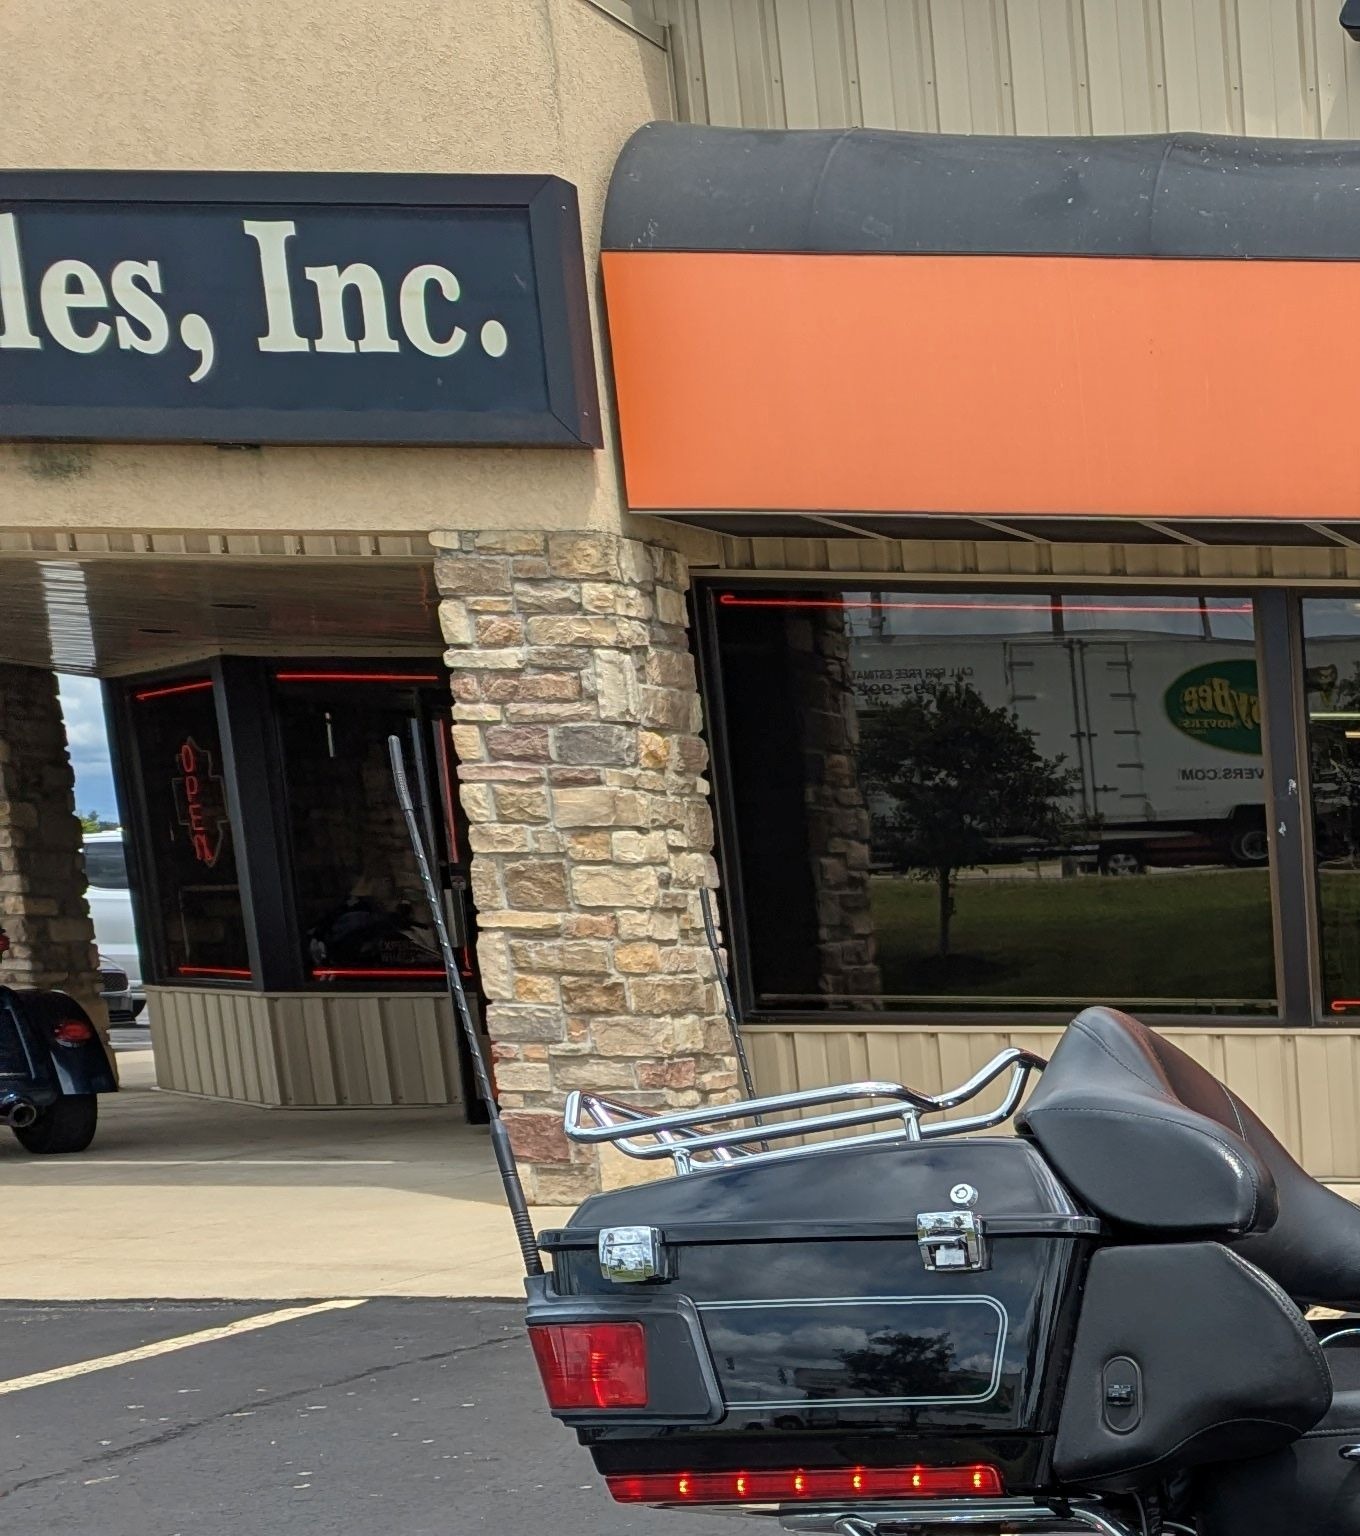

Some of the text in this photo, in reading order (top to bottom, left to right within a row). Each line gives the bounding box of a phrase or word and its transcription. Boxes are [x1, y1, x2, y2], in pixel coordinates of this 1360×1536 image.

[0, 211, 509, 383] les, Inc.
[181, 744, 214, 861] OPEN
